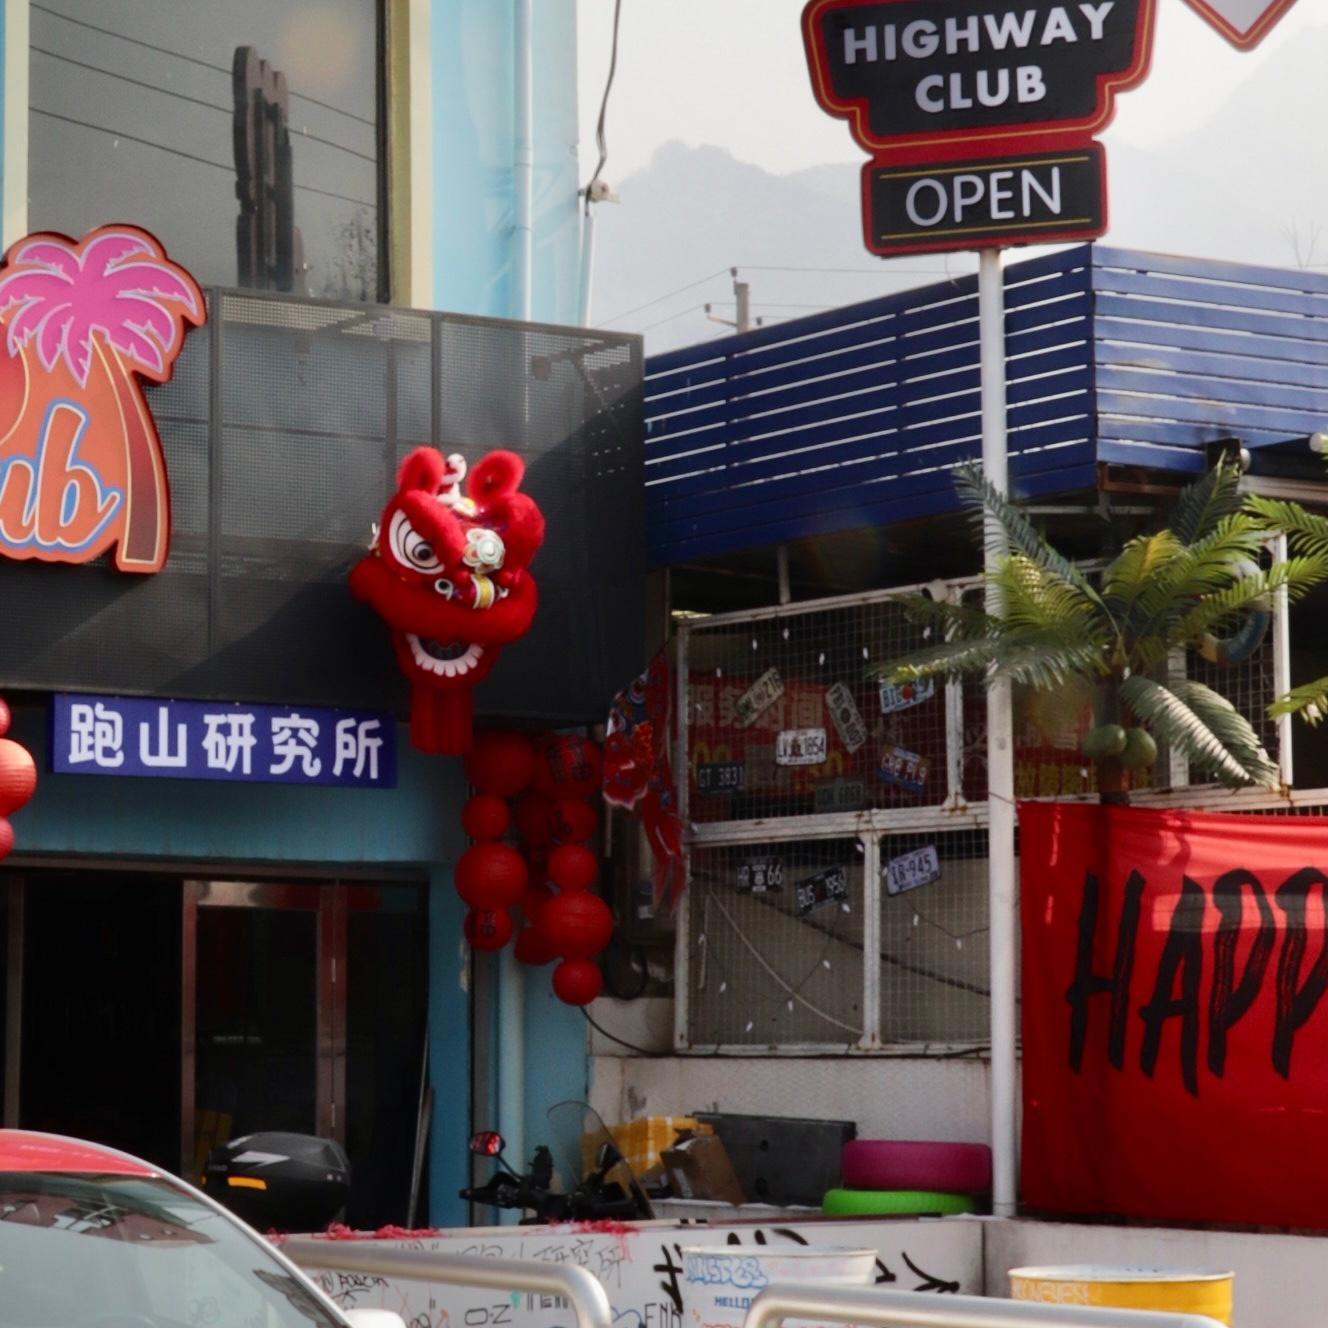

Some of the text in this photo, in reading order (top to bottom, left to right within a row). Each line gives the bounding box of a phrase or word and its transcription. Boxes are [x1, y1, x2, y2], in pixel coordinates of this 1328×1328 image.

[843, 0, 1115, 66] HIGHWAY
[914, 65, 1048, 114] CLUB
[904, 165, 1062, 228] OPEN
[67, 701, 384, 780] 跑山研究所
